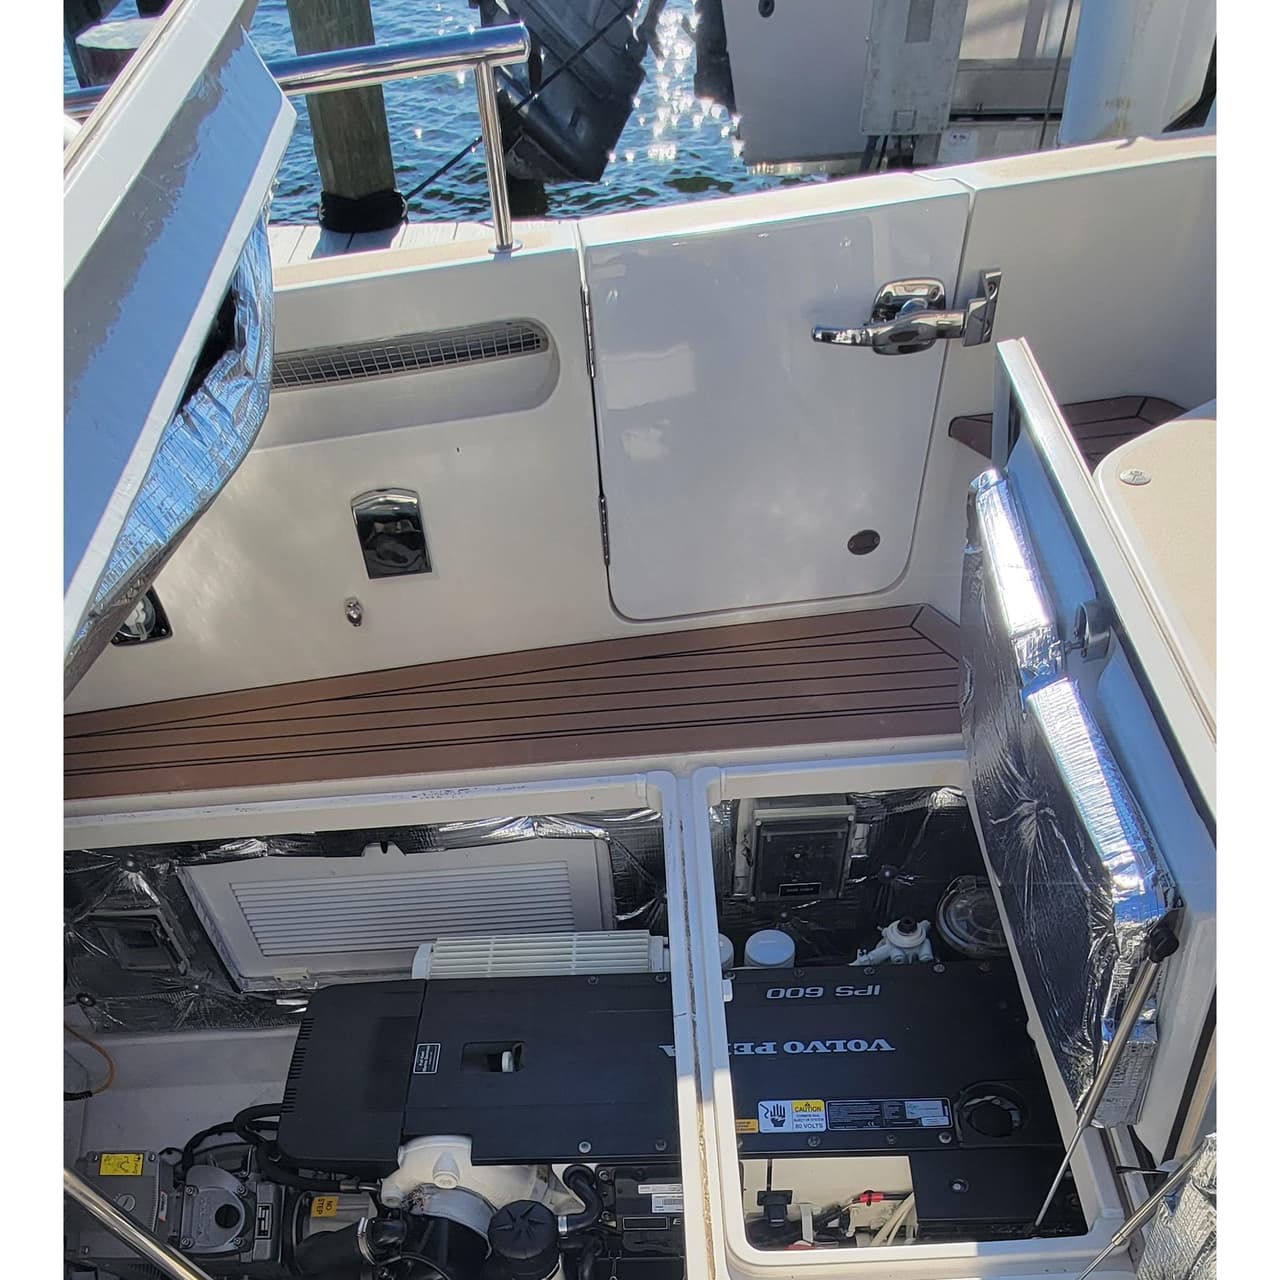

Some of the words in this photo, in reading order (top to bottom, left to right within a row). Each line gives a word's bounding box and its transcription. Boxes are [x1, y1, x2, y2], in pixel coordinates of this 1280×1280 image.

[766, 986, 824, 999] 600
[835, 984, 881, 996] IPS
[783, 1038, 896, 1054] VOLVO
[317, 1198, 325, 1215] STEP
[326, 1200, 333, 1211] NO
